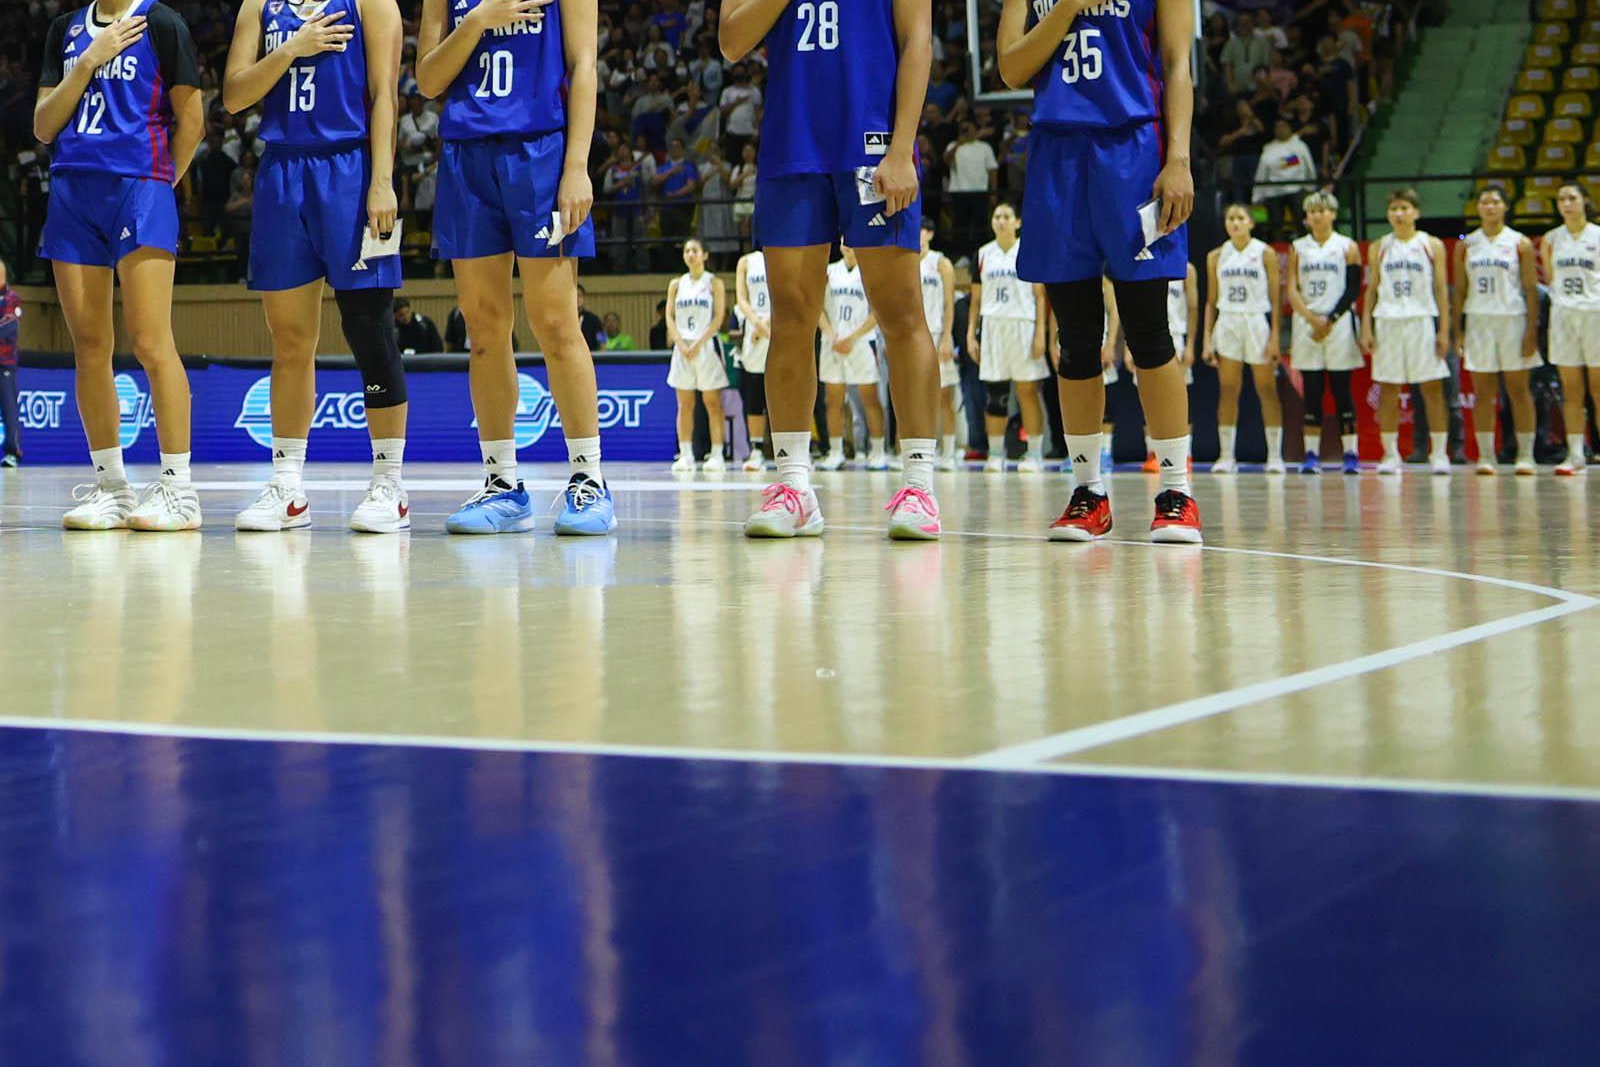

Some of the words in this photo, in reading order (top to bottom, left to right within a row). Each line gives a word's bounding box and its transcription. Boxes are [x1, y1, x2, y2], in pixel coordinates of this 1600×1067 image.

[797, 1, 839, 51] 28
[475, 50, 513, 97] 20
[1062, 29, 1102, 84] 35
[289, 66, 316, 112] 13
[77, 91, 106, 134] 12
[995, 286, 1009, 303] 16
[1228, 285, 1247, 303] 29
[1478, 277, 1495, 294] 91
[687, 316, 695, 331] 6
[839, 305, 853, 322] 10
[311, 392, 368, 429] AO
